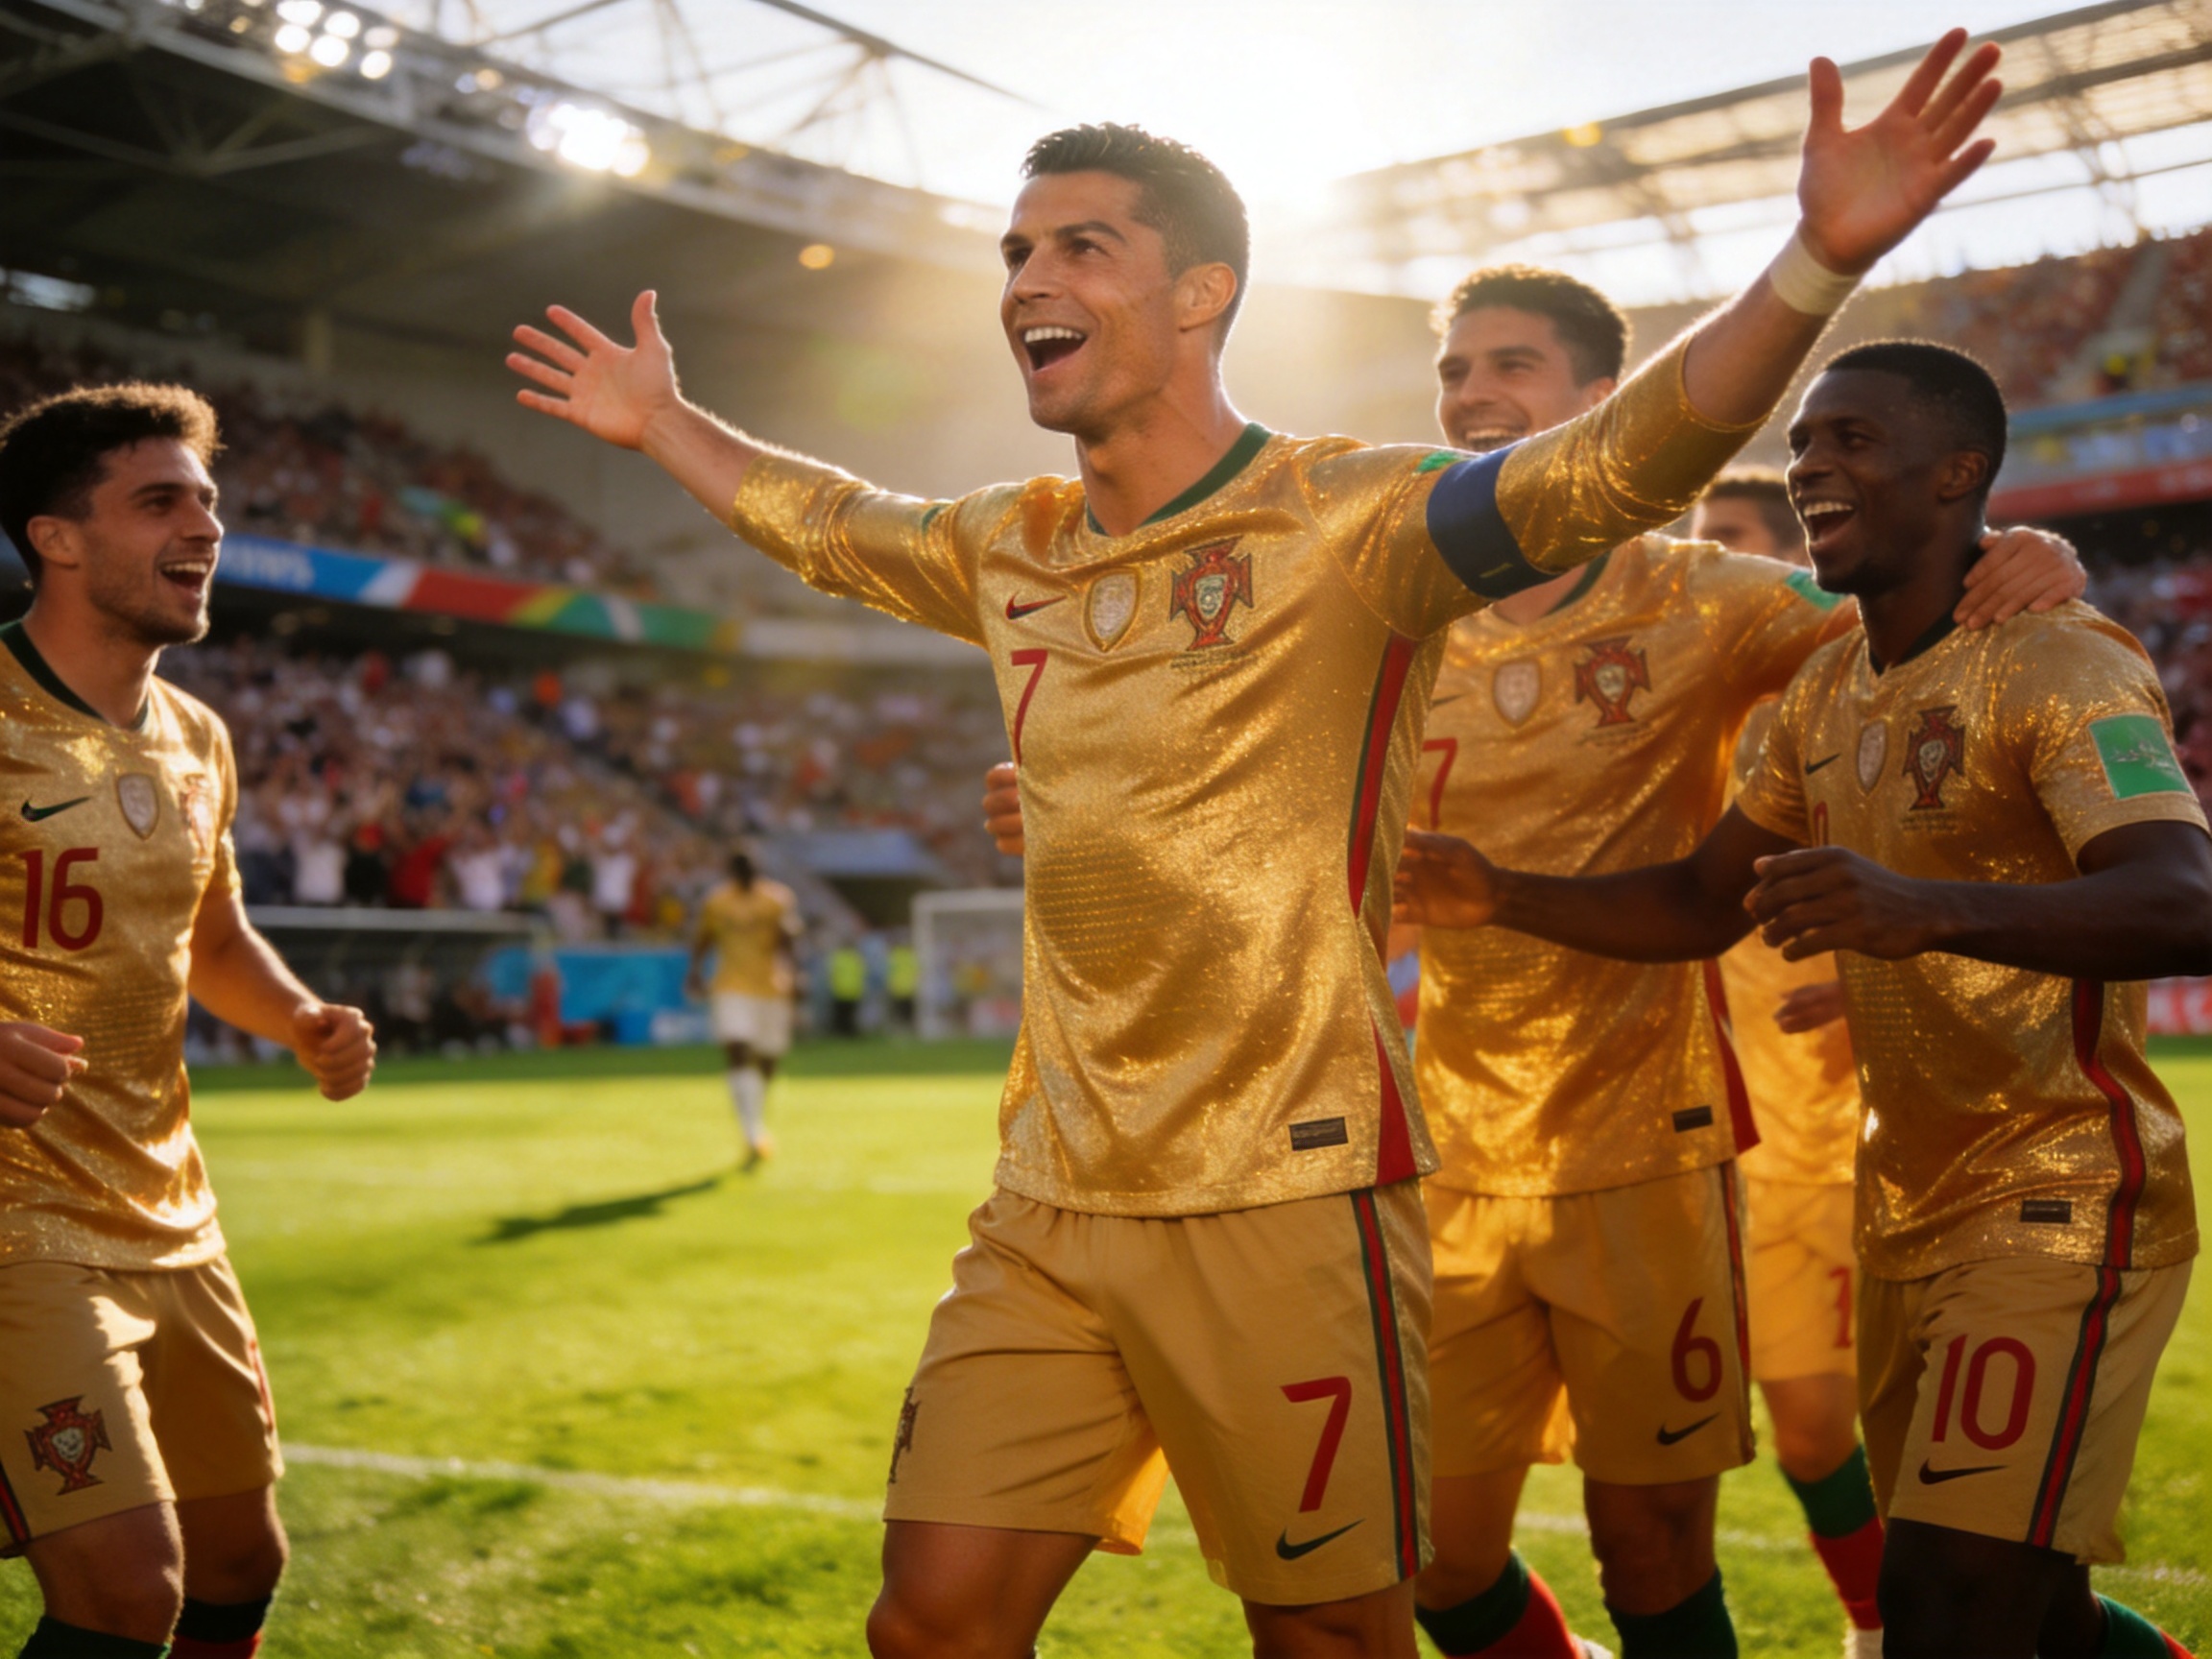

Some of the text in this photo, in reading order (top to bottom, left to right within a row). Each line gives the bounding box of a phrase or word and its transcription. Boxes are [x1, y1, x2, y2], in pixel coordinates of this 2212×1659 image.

[1010, 648, 1048, 768] 7
[1422, 737, 1458, 830] 7
[18, 847, 104, 951] 16
[1671, 1297, 1723, 1403] 6
[1932, 1333, 2036, 1451] 10
[1280, 1376, 1353, 1513] 7
